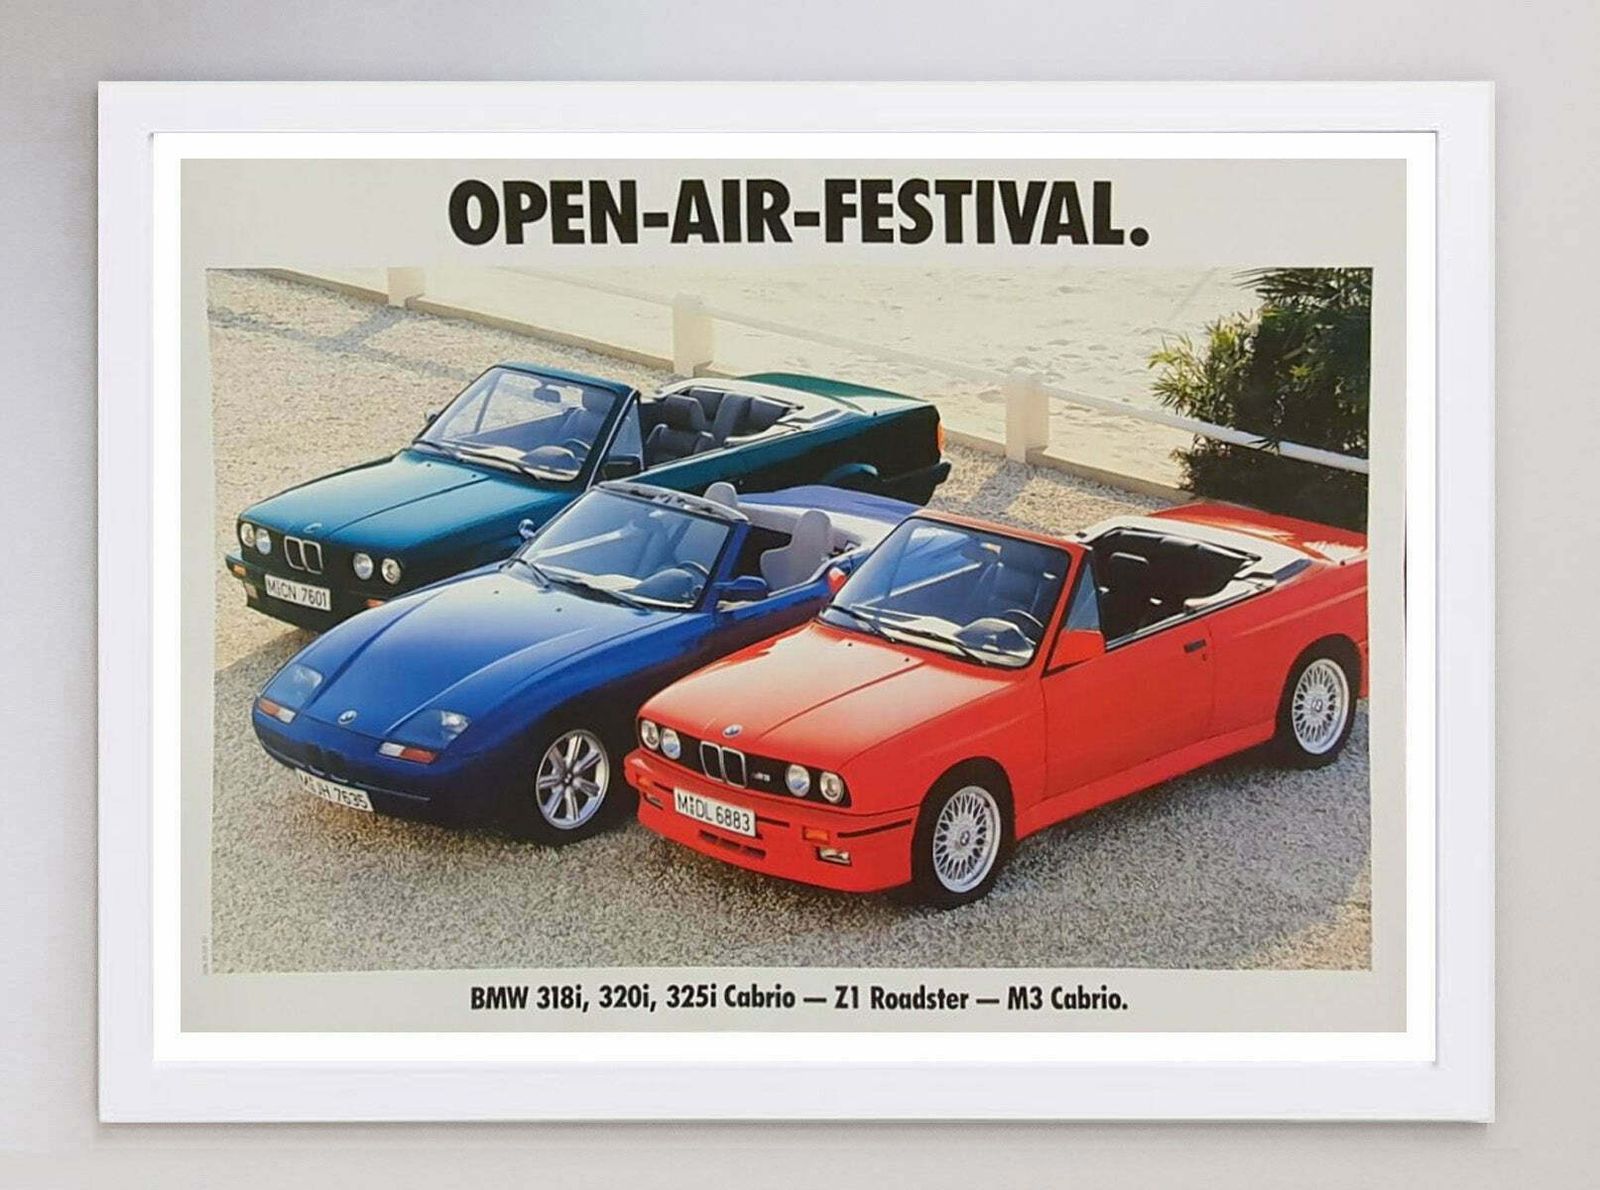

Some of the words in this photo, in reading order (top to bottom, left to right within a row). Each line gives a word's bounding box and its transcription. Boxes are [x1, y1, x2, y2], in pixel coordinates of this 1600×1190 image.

[449, 179, 1149, 247] OPEN-AIR-FESTIVAL.
[301, 586, 327, 609] 7601
[715, 805, 751, 832] 6883
[471, 986, 529, 1010] BMW
[537, 984, 589, 1013] 318i,
[600, 984, 657, 1013] 320i,
[667, 984, 717, 1009] 325i
[724, 983, 796, 1009] Cabrio
[835, 985, 860, 1009] Z1
[870, 984, 969, 1010] Roadster
[1007, 986, 1043, 1010] M3
[1050, 984, 1128, 1010] Cabrio.
